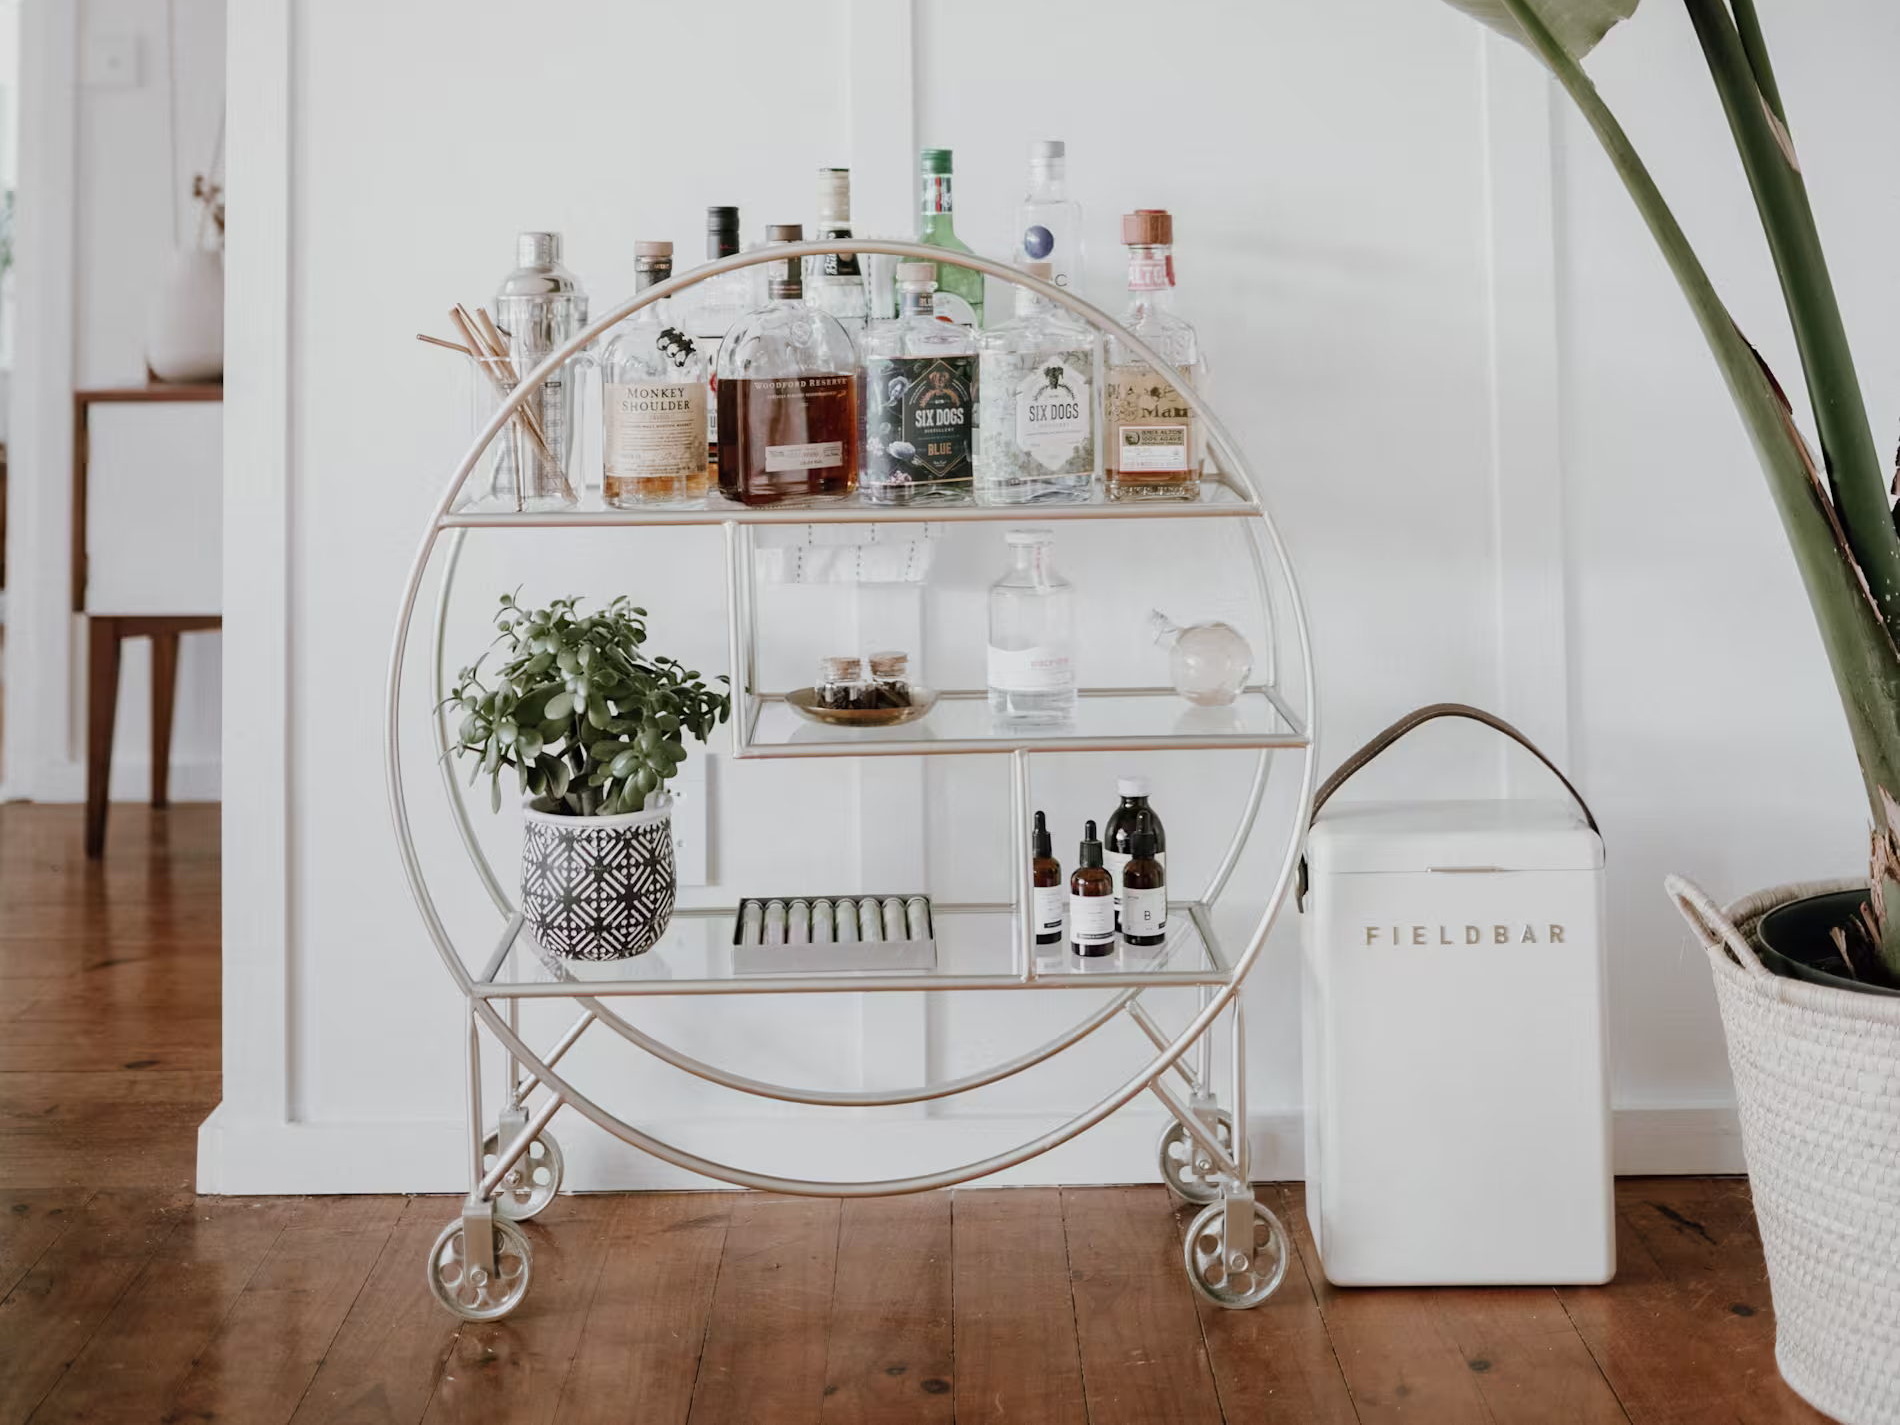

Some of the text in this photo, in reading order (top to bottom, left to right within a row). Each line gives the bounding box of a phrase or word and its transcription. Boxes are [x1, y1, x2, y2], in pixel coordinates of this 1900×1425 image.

[754, 378, 848, 390] WOODFORD RESERVE
[628, 387, 685, 399] MONKEY
[622, 400, 691, 412] SHOULDER
[1029, 402, 1079, 422] SIX DOGS
[915, 407, 965, 428] SIX DOGS
[927, 442, 953, 456] BLUE
[1144, 910, 1151, 921] B
[1365, 924, 1566, 946] FIELDBAR
